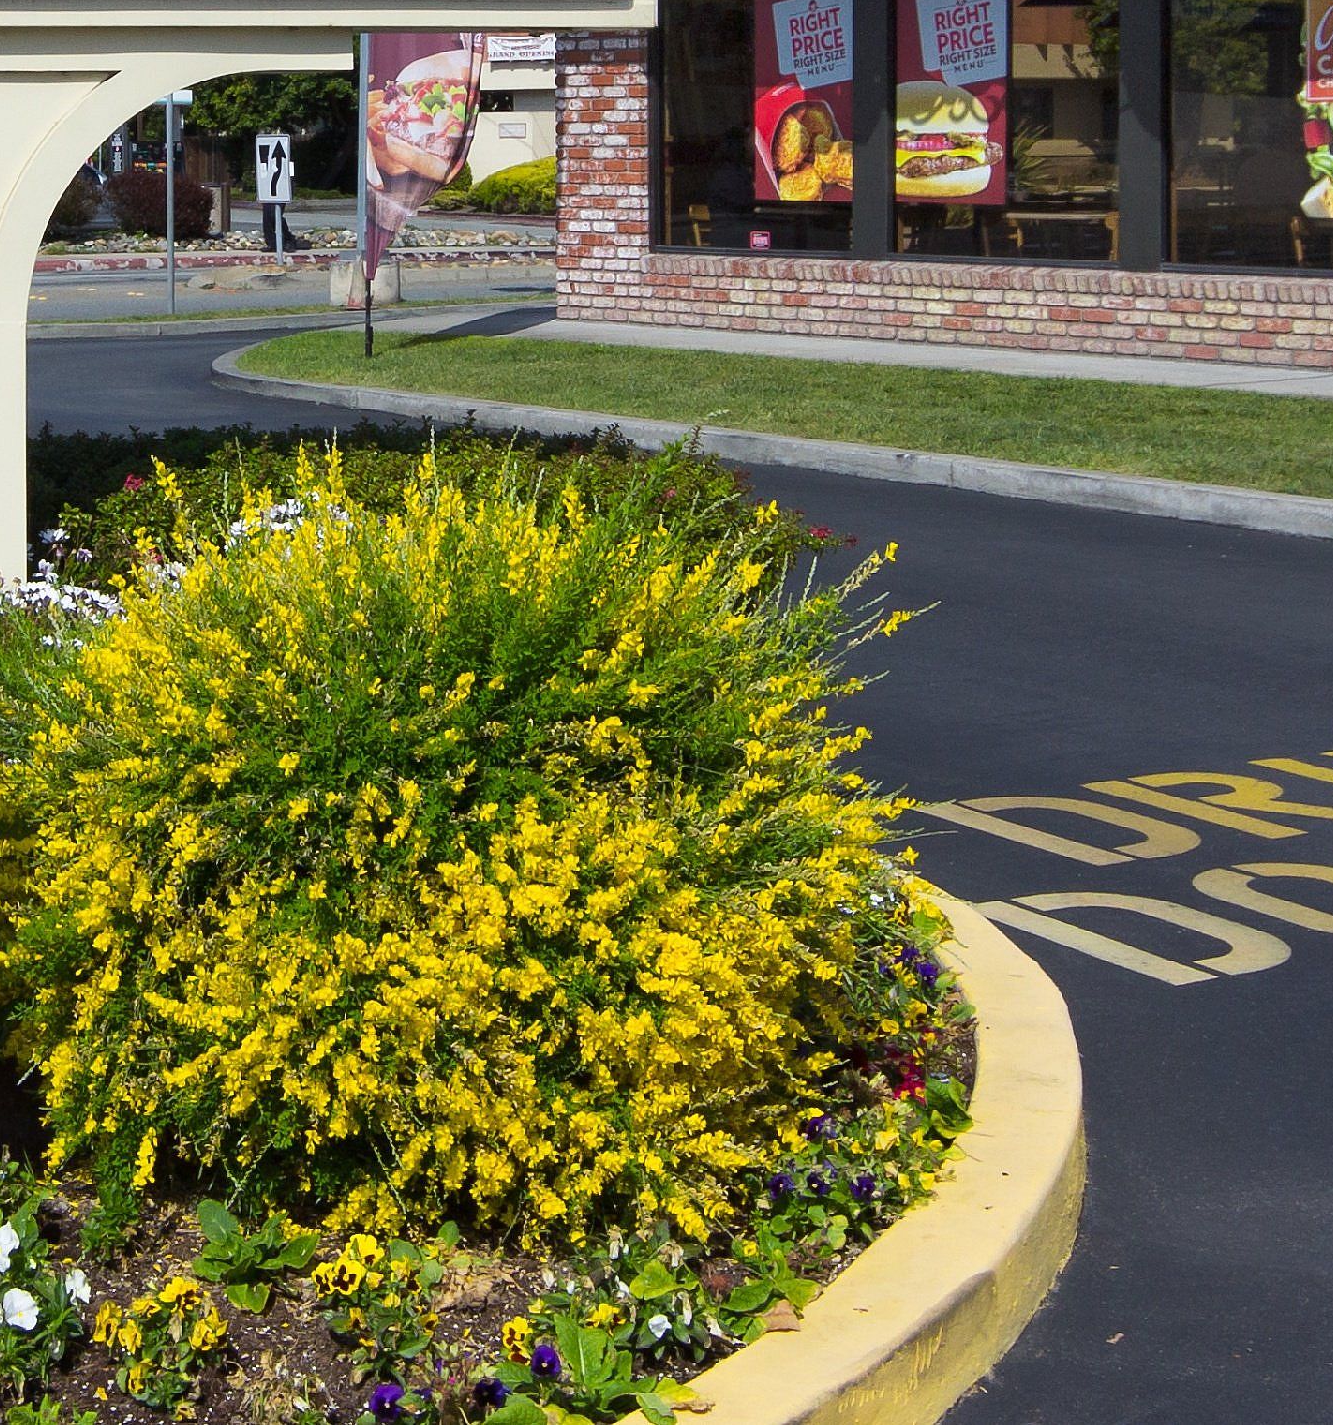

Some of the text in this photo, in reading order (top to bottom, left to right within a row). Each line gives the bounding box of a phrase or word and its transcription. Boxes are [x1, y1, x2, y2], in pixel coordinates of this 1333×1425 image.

[789, 7, 841, 36] RIGHT
[934, 1, 991, 31] RIGHT
[791, 27, 845, 58] PRICE
[936, 22, 996, 53] PRICE
[806, 63, 835, 76] MENU
[953, 60, 985, 73] MENU
